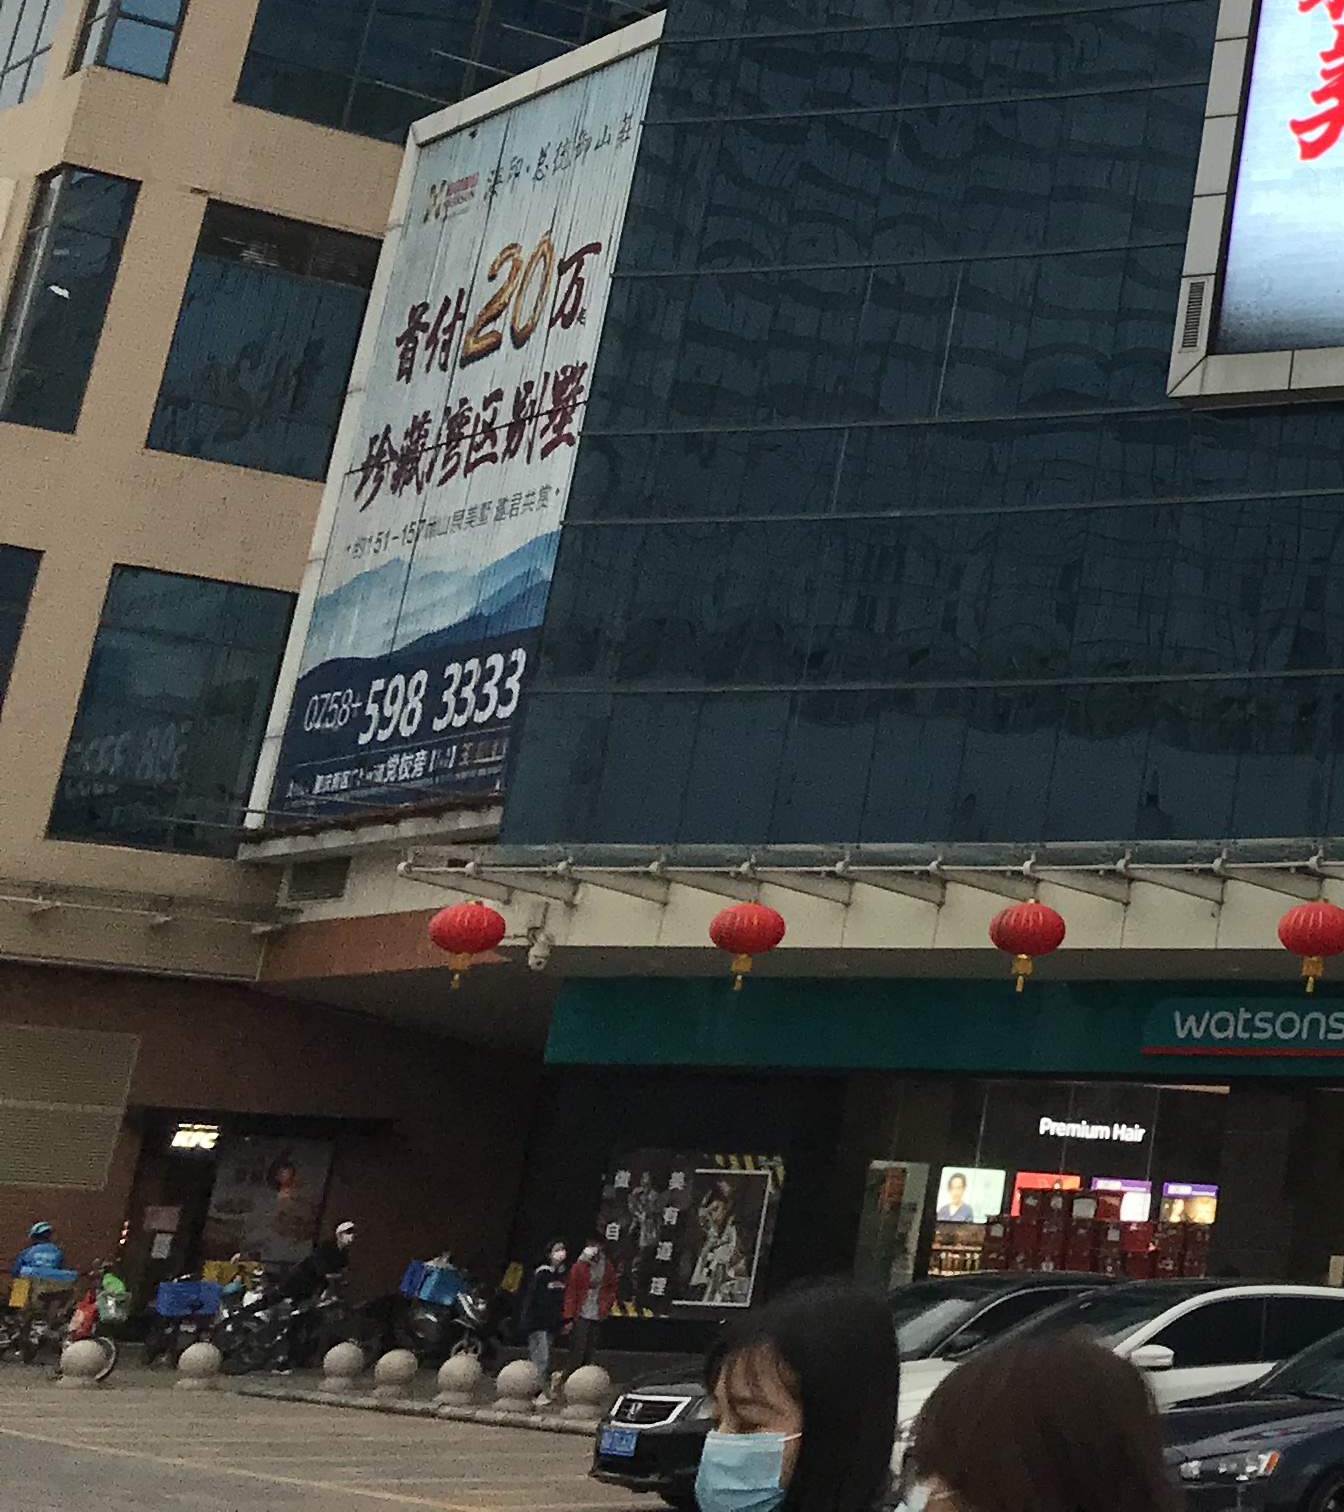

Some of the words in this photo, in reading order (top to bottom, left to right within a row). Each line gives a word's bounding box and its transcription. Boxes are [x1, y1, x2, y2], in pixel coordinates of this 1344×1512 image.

[432, 648, 527, 732] 3333
[1039, 1117, 1110, 1140] Premium
[1113, 1123, 1147, 1142] Hair
